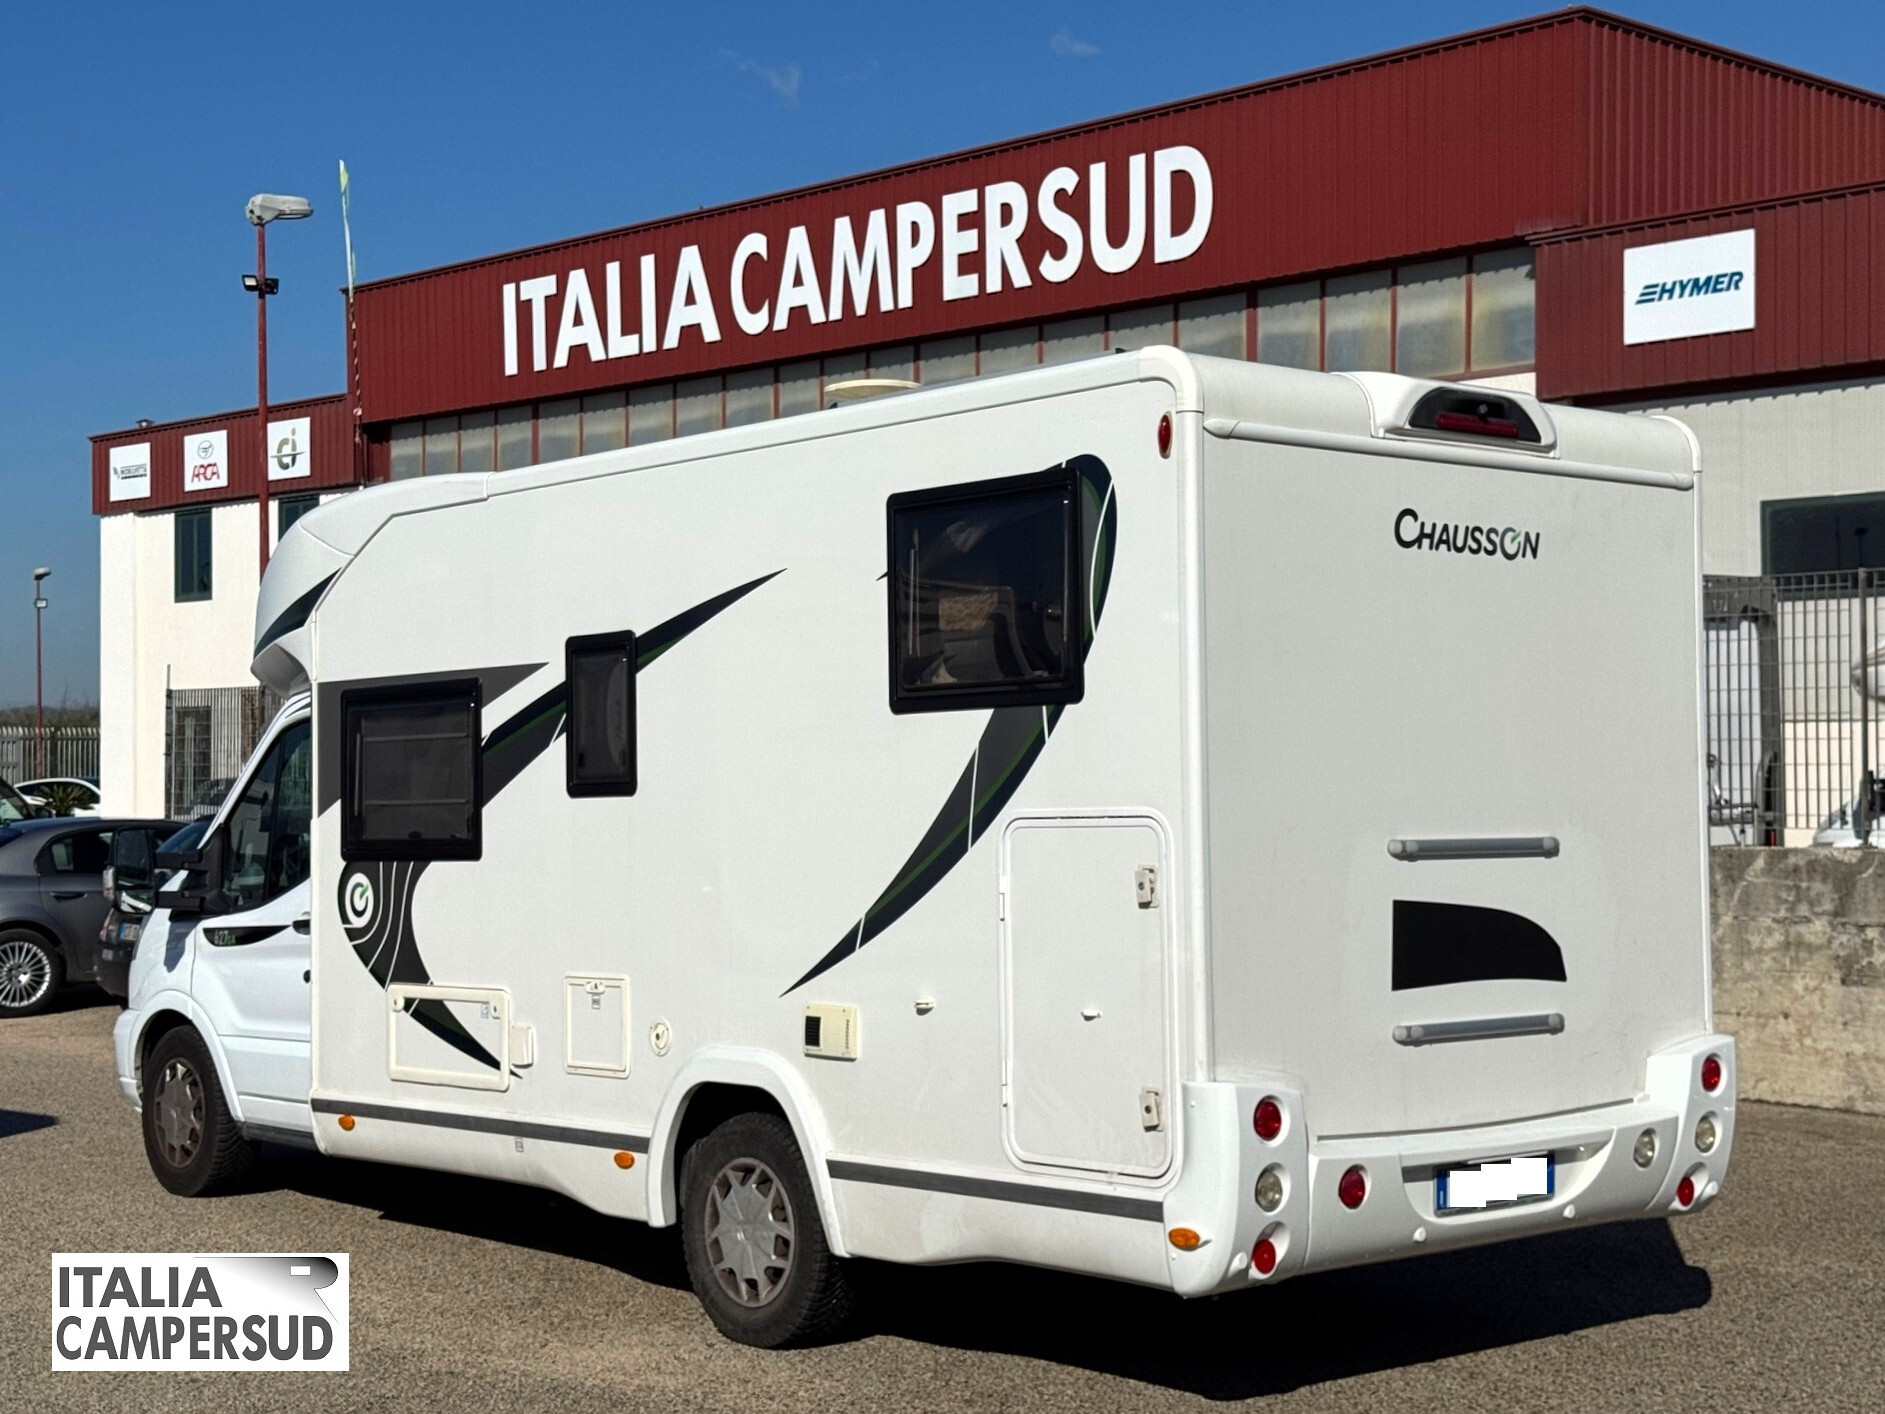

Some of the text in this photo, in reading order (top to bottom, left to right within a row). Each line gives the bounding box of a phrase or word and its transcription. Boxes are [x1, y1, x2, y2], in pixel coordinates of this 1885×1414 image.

[502, 145, 1214, 377] ITALIA CAMPERSUD
[1656, 270, 1744, 302] HYMER
[190, 462, 220, 483] ARCA
